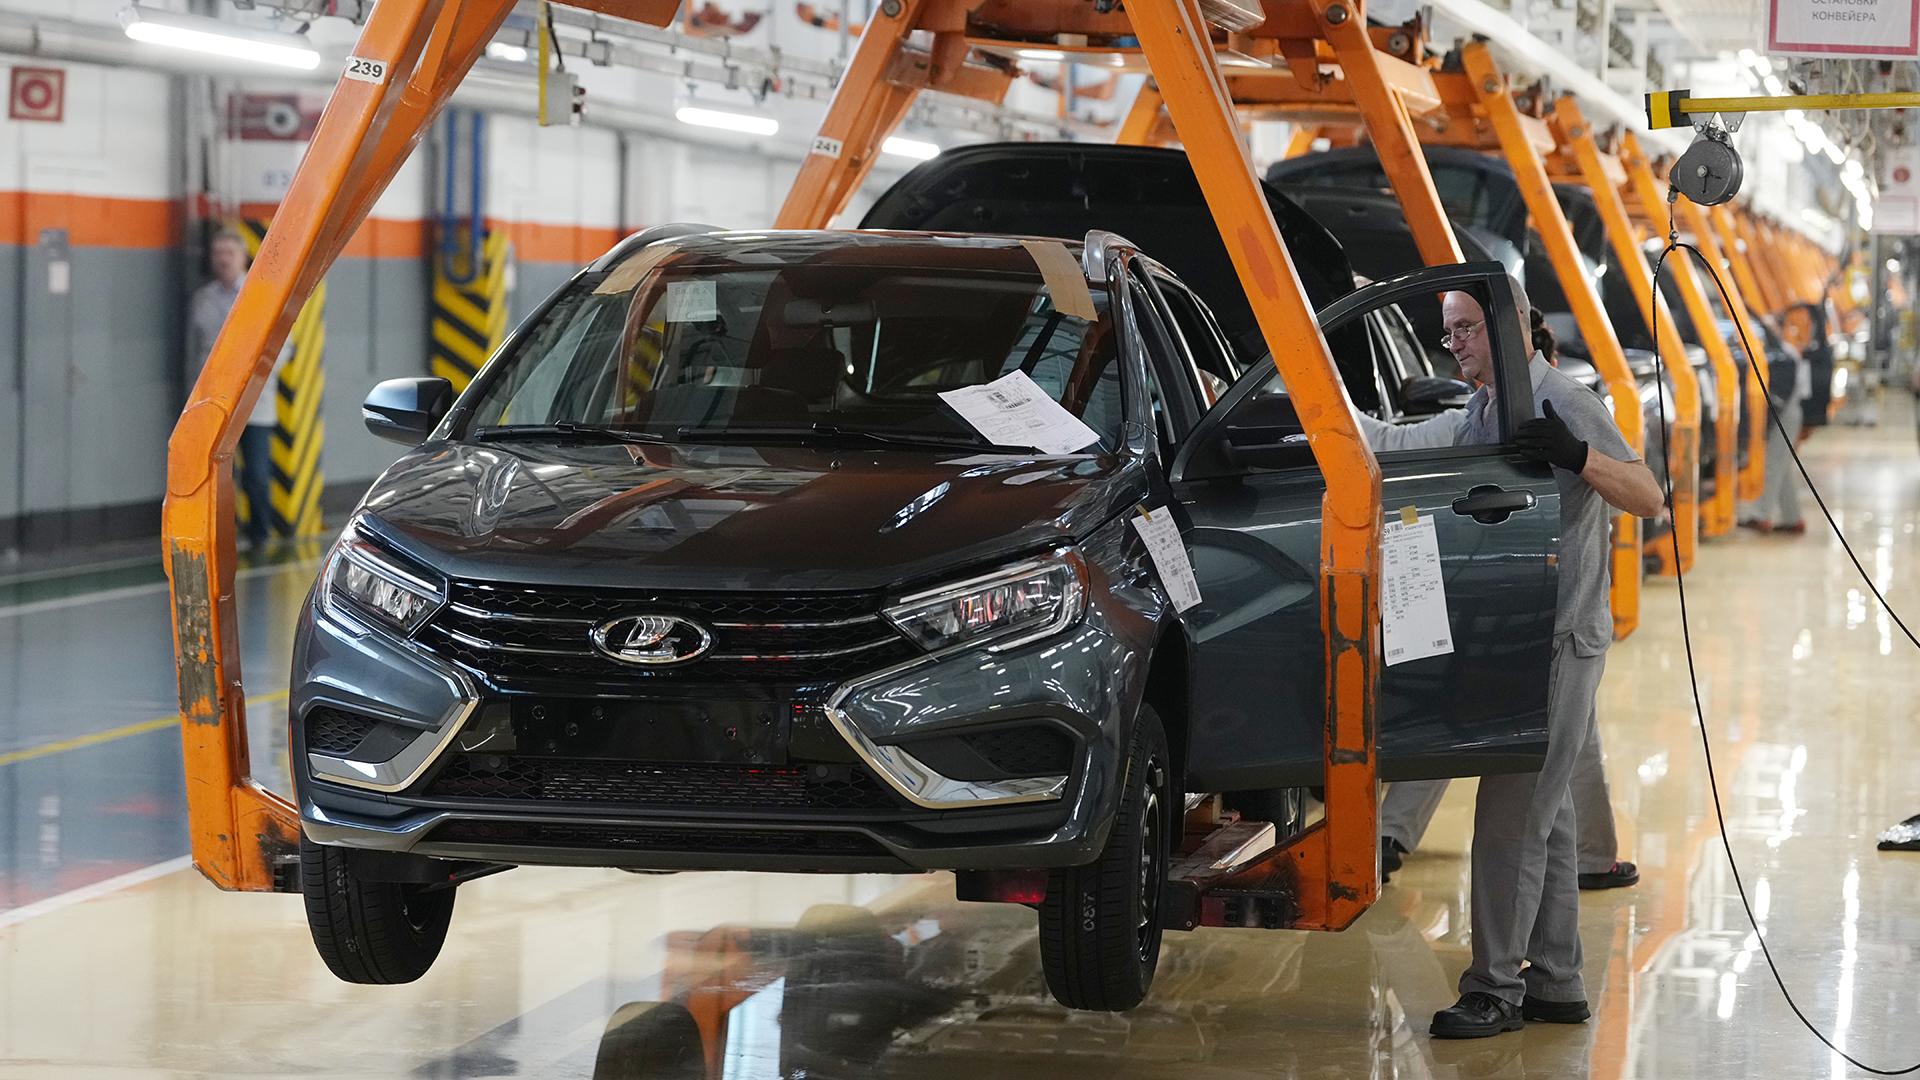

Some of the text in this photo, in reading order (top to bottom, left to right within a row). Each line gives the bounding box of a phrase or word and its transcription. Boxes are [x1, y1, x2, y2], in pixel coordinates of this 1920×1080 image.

[1811, 10, 1876, 21] КОНВЕЙЕРА
[350, 60, 382, 78] 239
[815, 140, 838, 153] 241
